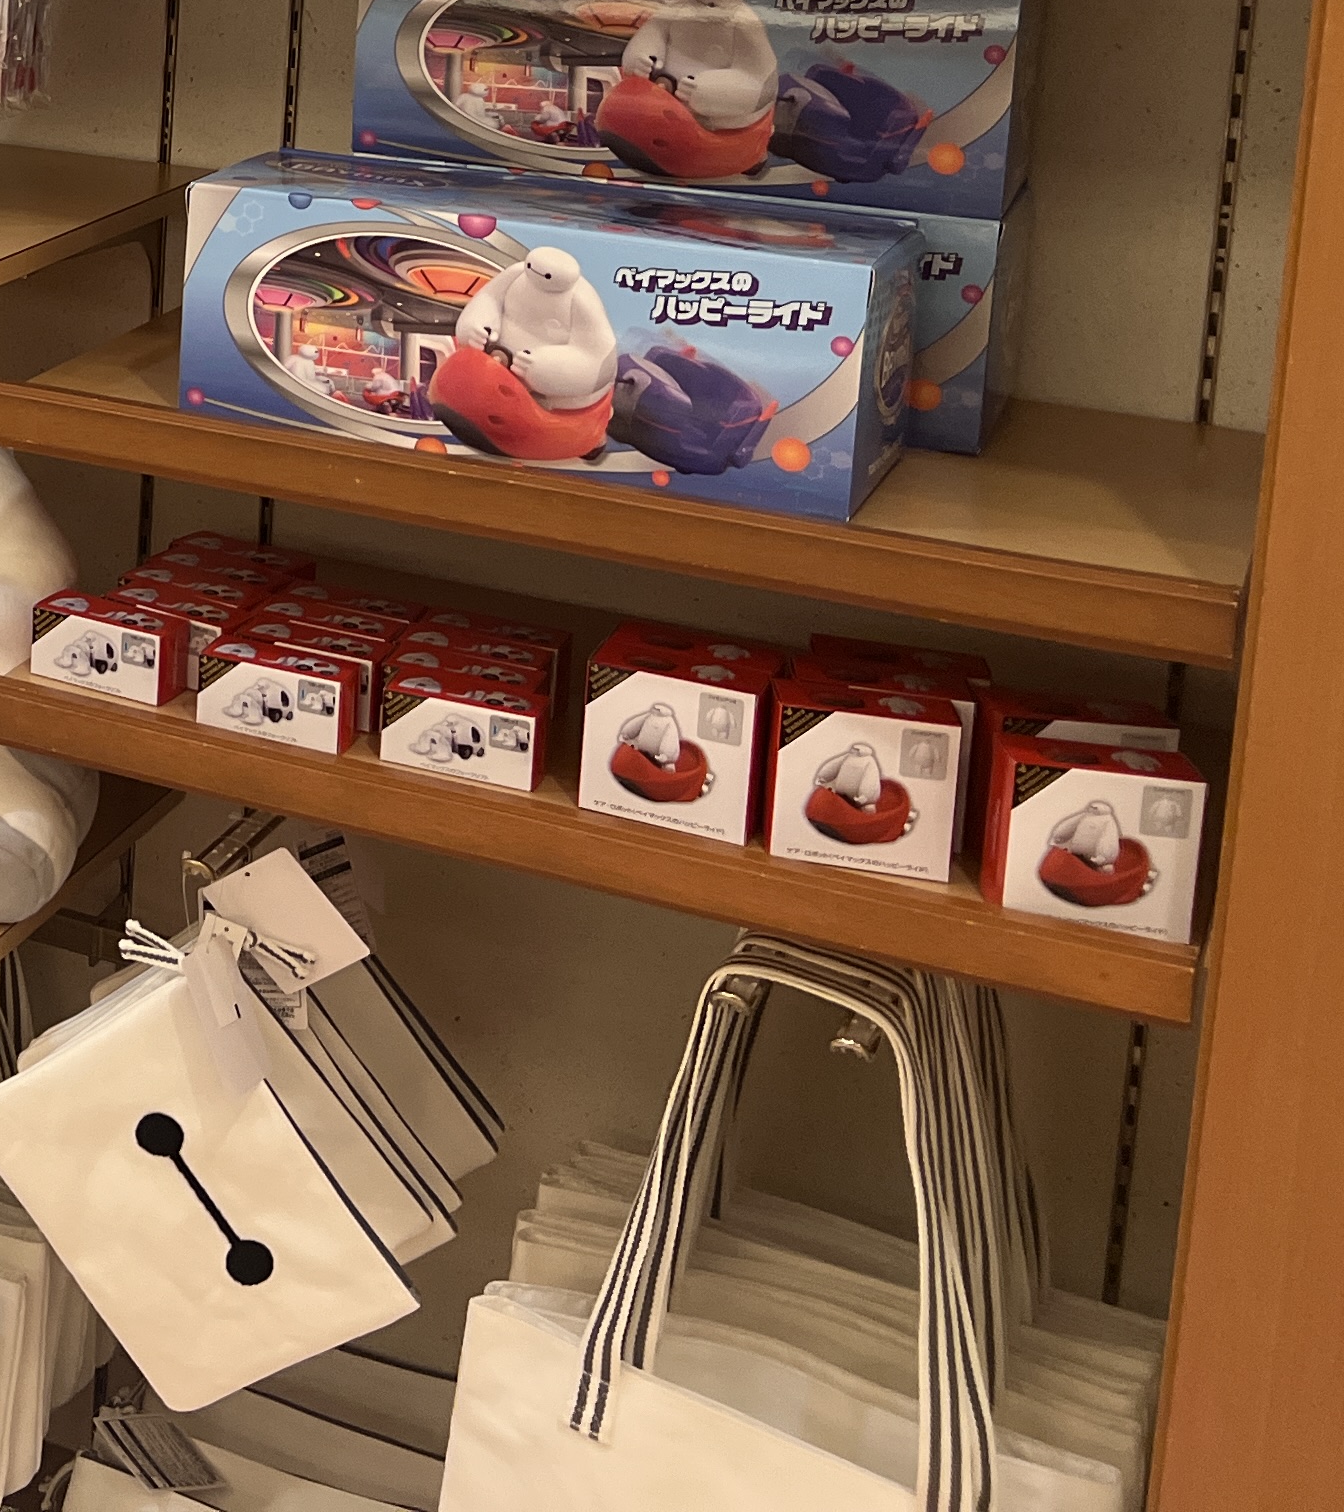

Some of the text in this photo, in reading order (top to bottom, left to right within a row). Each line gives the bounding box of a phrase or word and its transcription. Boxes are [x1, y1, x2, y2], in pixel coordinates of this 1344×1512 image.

[810, 14, 984, 43] ハッピーライド
[614, 266, 759, 296] ベイマックスの
[650, 294, 833, 331] ハッピーライド
